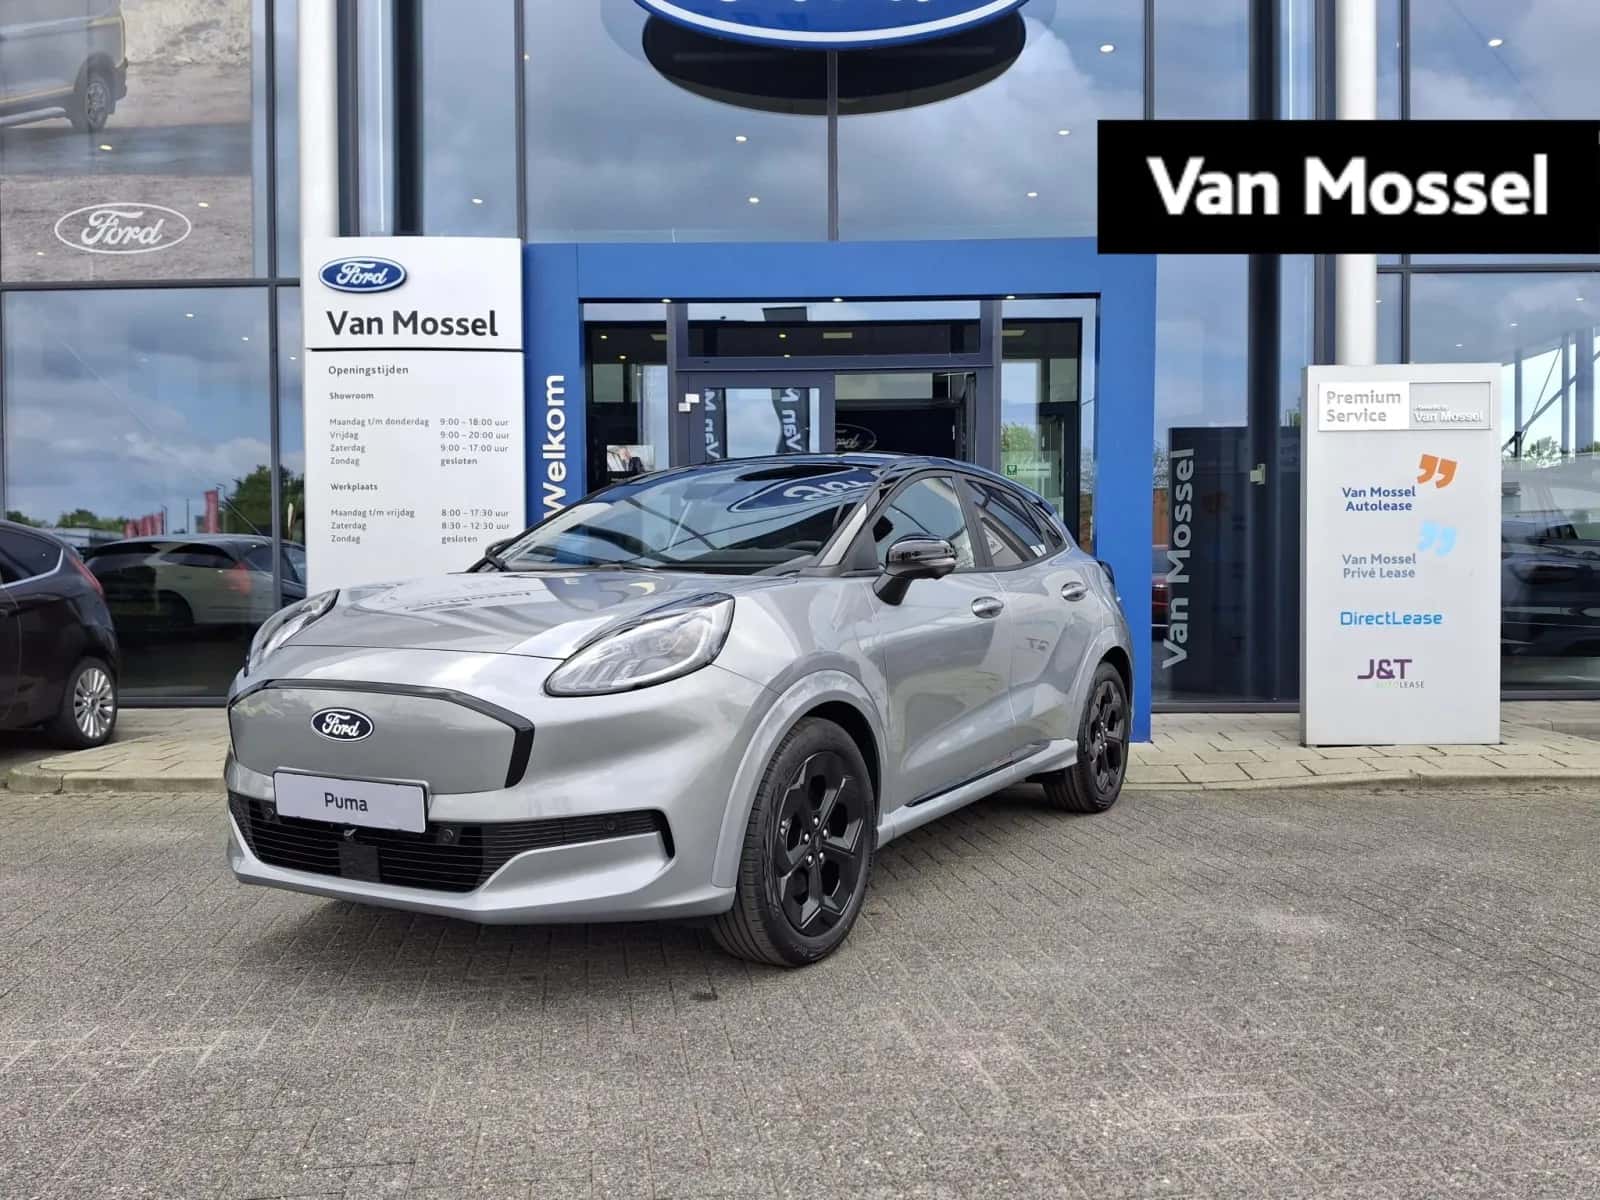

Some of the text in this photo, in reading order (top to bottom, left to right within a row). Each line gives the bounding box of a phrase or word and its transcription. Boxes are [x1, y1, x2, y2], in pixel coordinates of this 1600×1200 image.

[80, 209, 165, 245] Ford
[335, 261, 389, 285] Ford
[326, 310, 498, 336] Van Mossel
[328, 365, 409, 377] Openingstijden
[329, 392, 375, 400] Showroom
[1326, 389, 1401, 405] Premium
[1326, 407, 1387, 423] Service
[329, 417, 430, 427] Maandag t/m donderdag
[439, 418, 460, 426] 9:00
[494, 419, 510, 427] uur
[329, 431, 359, 441] Vrijdag
[439, 431, 460, 440] 9:00
[468, 431, 494, 440] 20:00
[495, 432, 510, 440] uur
[329, 444, 366, 454] Zaterdag
[440, 444, 460, 453] 9:00
[469, 444, 493, 453] 17:00
[494, 445, 509, 453] uur
[542, 375, 567, 520] Welkom
[329, 457, 361, 467] Zondag
[440, 457, 478, 467] gesloten
[330, 482, 379, 492] Werkplaats
[1341, 486, 1417, 498] Van Mossel
[1345, 500, 1413, 512] Autolease
[330, 509, 415, 518] Maandag t/m vrijdag
[469, 509, 493, 517] 17:30
[330, 522, 367, 531] Zaterdag
[469, 522, 494, 530] 12:30
[330, 535, 361, 544] Zondag
[441, 535, 478, 545] gesloten
[1162, 448, 1195, 669] Van Mossel
[1341, 553, 1417, 565] Van Mossel
[1343, 567, 1416, 579] Privé Lease
[1340, 611, 1443, 626] DirectLease
[1357, 658, 1413, 680] J&T
[322, 712, 361, 737] Ford
[324, 792, 369, 812] Puma
